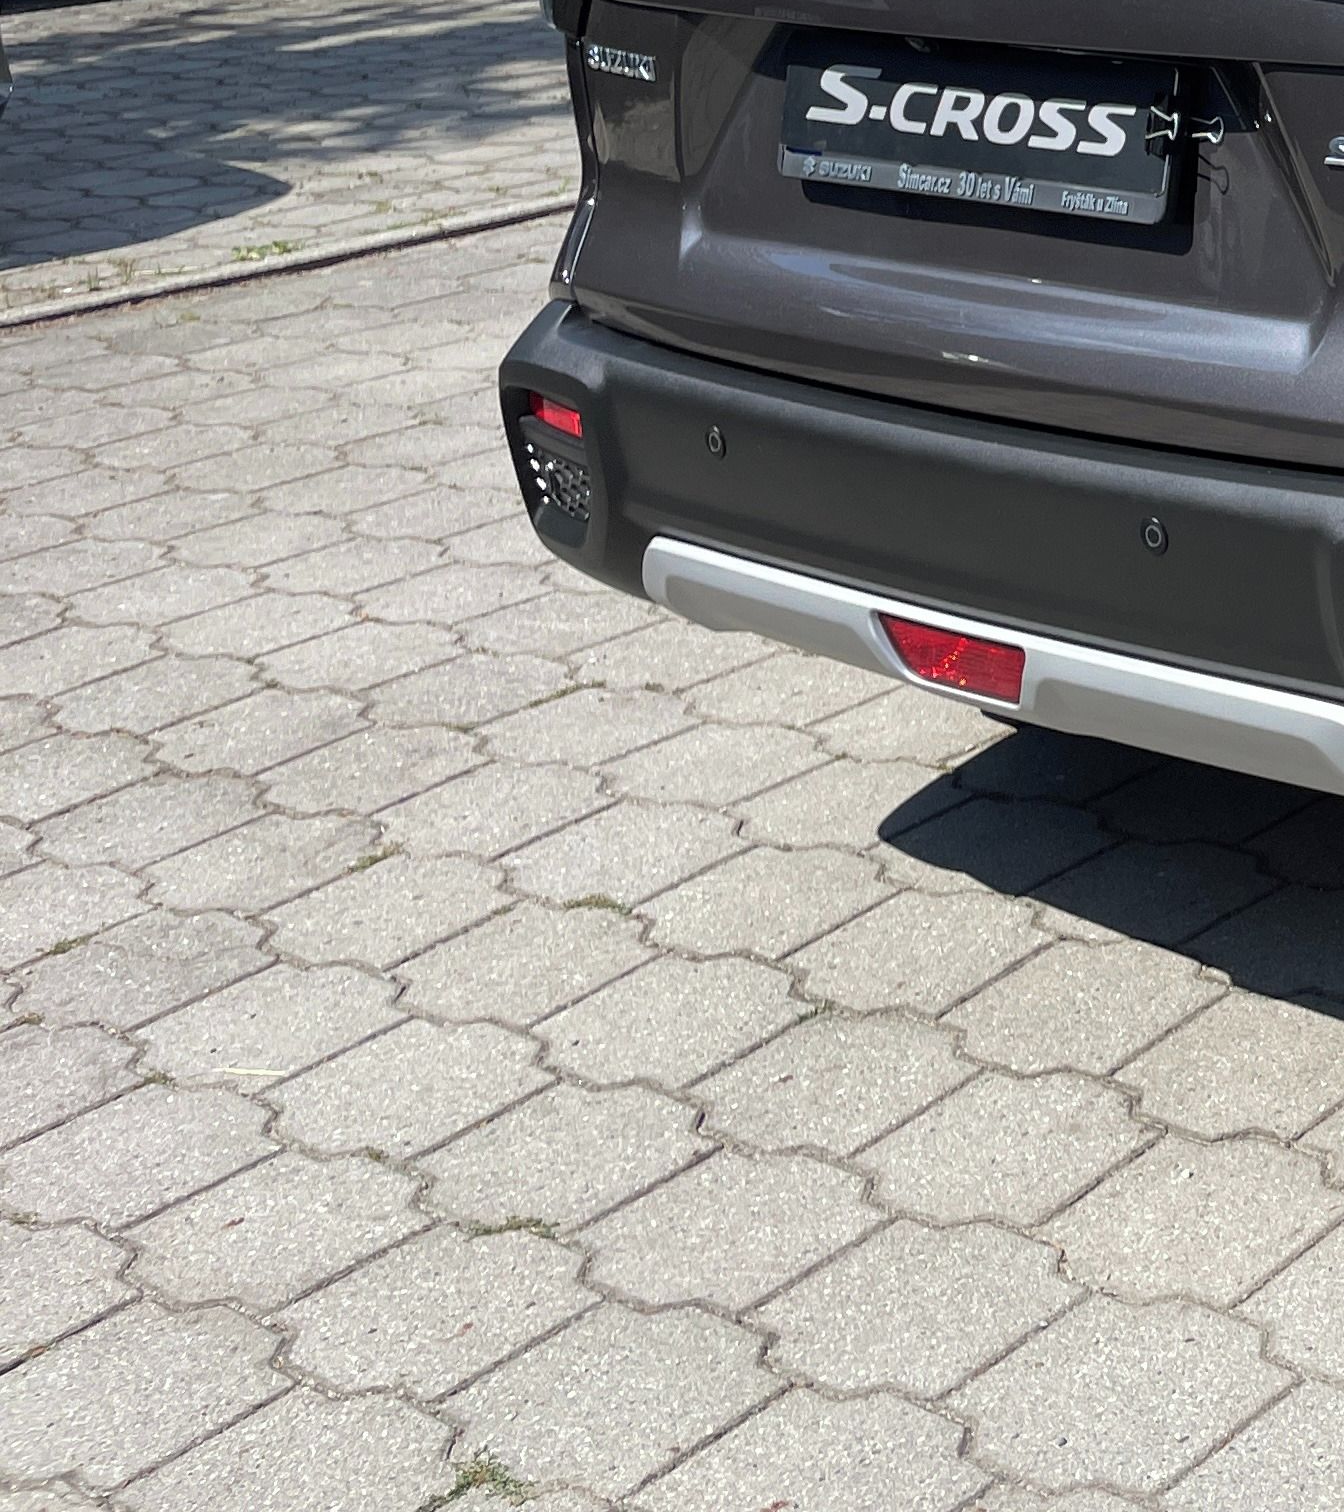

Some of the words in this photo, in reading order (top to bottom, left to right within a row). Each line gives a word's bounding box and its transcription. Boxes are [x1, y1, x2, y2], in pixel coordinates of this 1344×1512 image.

[587, 44, 657, 83] SUZUKI
[805, 63, 1138, 157] S-CROSS
[818, 160, 872, 182] SUZUKI
[897, 162, 953, 194] Simcar.cz
[957, 170, 977, 198] 30
[976, 176, 992, 200] let
[1004, 175, 1035, 206] Vámi
